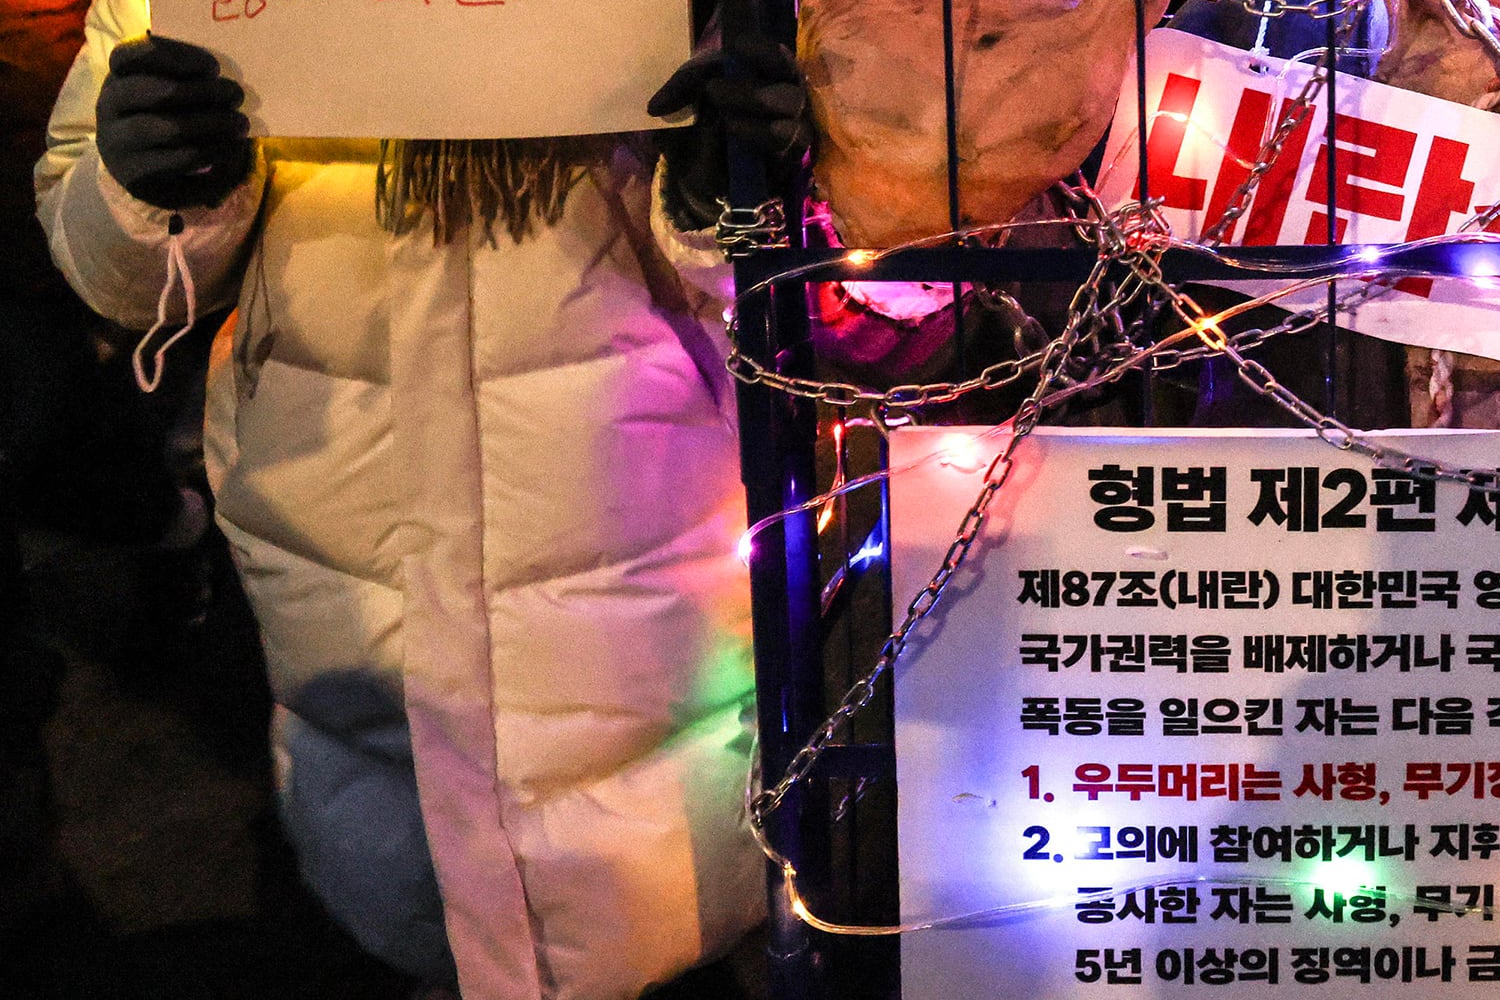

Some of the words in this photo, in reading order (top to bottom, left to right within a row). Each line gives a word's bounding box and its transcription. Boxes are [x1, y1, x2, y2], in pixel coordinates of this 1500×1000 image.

[1088, 465, 1226, 532] 형법
[1248, 467, 1436, 532] 제2편
[1017, 570, 1279, 609] 제87조(내란)
[1292, 570, 1461, 609] 대한민국
[1019, 634, 1231, 673] 국가권력을
[1244, 634, 1455, 672] 배제하거나
[1020, 697, 1146, 735] 폭동을
[1160, 698, 1283, 736] 일으킨
[1295, 698, 1379, 736] 자는
[1392, 697, 1474, 735] 다음
[1021, 765, 1054, 802] 1.
[1073, 763, 1283, 801] 우두머리는
[1294, 762, 1389, 805] 사형,
[1023, 826, 1063, 862] 2.
[1210, 824, 1420, 862] 참여하거나
[1210, 887, 1293, 924] 자는
[1414, 885, 1493, 921] 무기
[1075, 948, 1141, 984] 5년
[1156, 948, 1278, 985] 이상의
[1291, 946, 1456, 984] 징역이나
